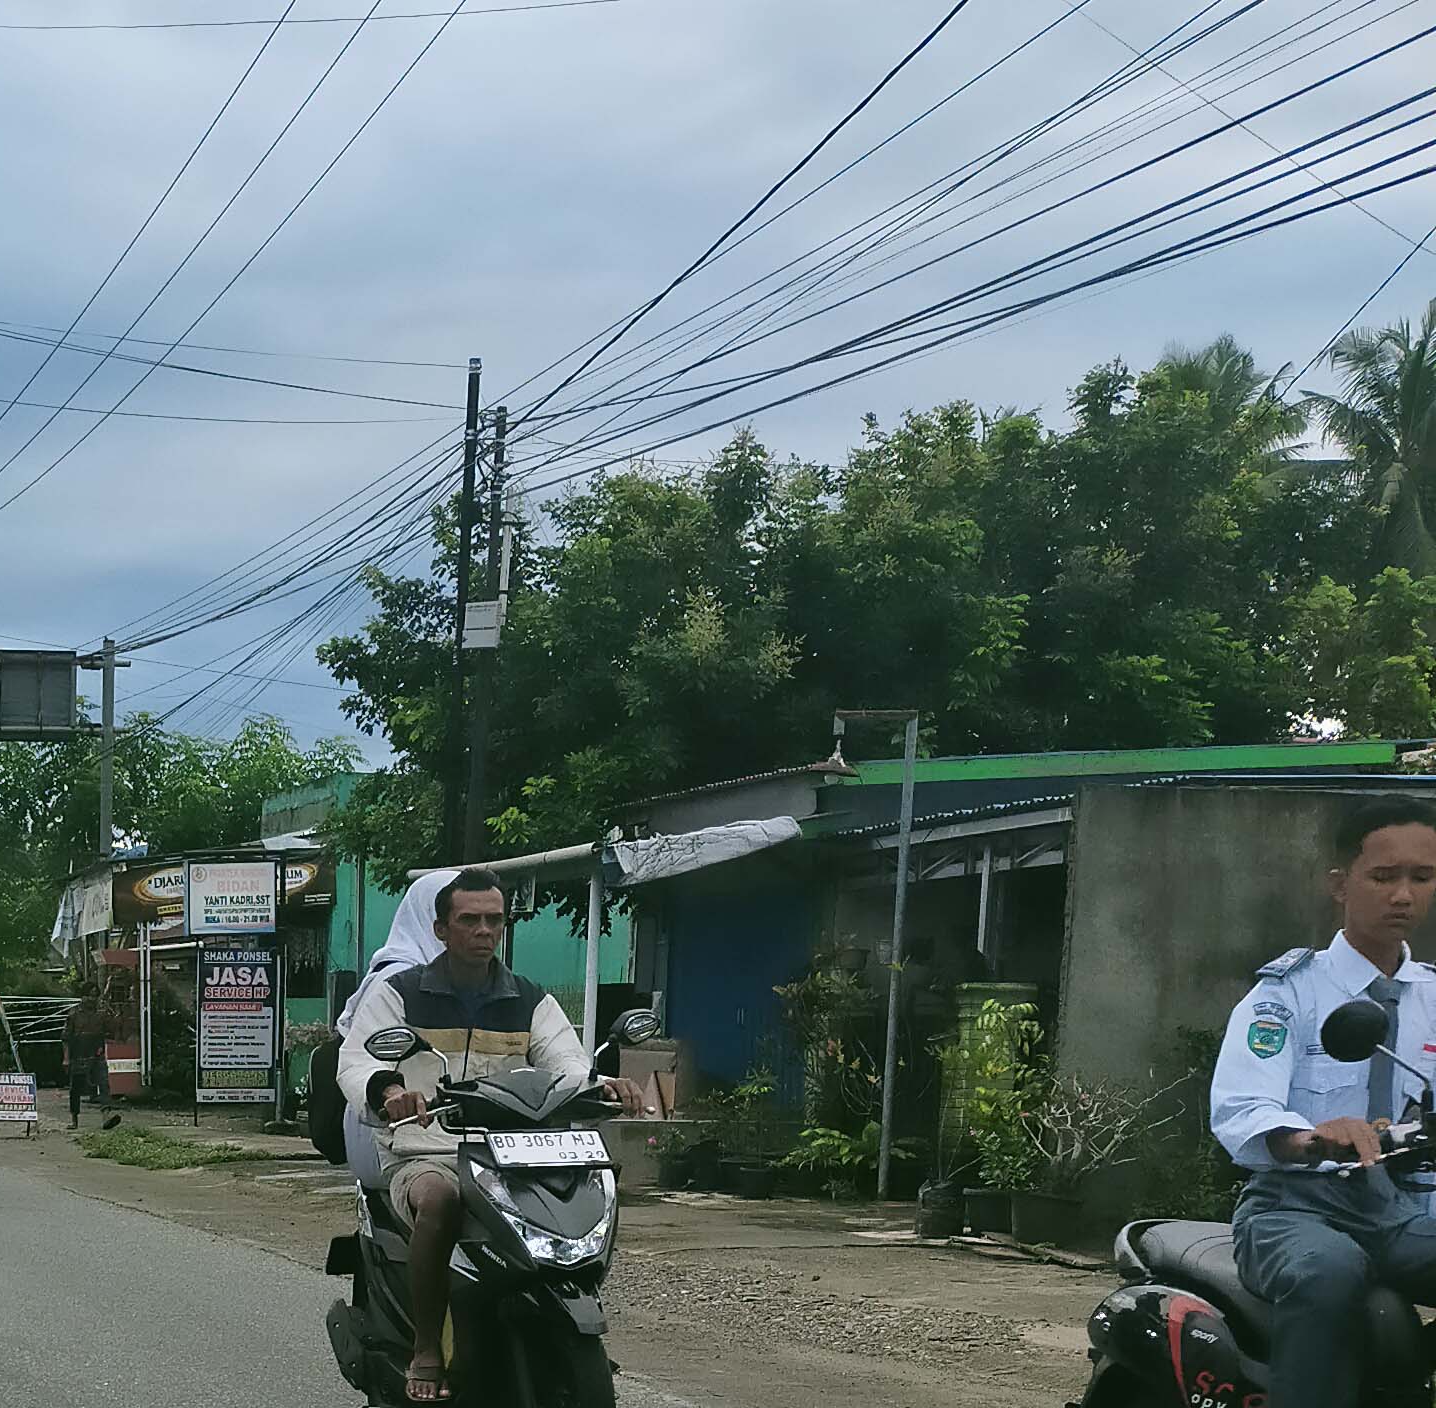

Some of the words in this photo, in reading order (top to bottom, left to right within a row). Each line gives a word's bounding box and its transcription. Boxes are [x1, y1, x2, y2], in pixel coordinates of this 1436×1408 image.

[217, 879, 261, 893] BIDAN
[204, 895, 228, 906] YANTI
[204, 951, 235, 961] SHAKA
[237, 951, 272, 961] PONSEL
[205, 966, 270, 986] JASA
[205, 987, 252, 998] SERVICE
[254, 987, 270, 998] HP
[493, 1135, 516, 1149] BD
[523, 1134, 563, 1148] 3067
[481, 1244, 507, 1269] HONDA
[1189, 1328, 1220, 1344] sporty
